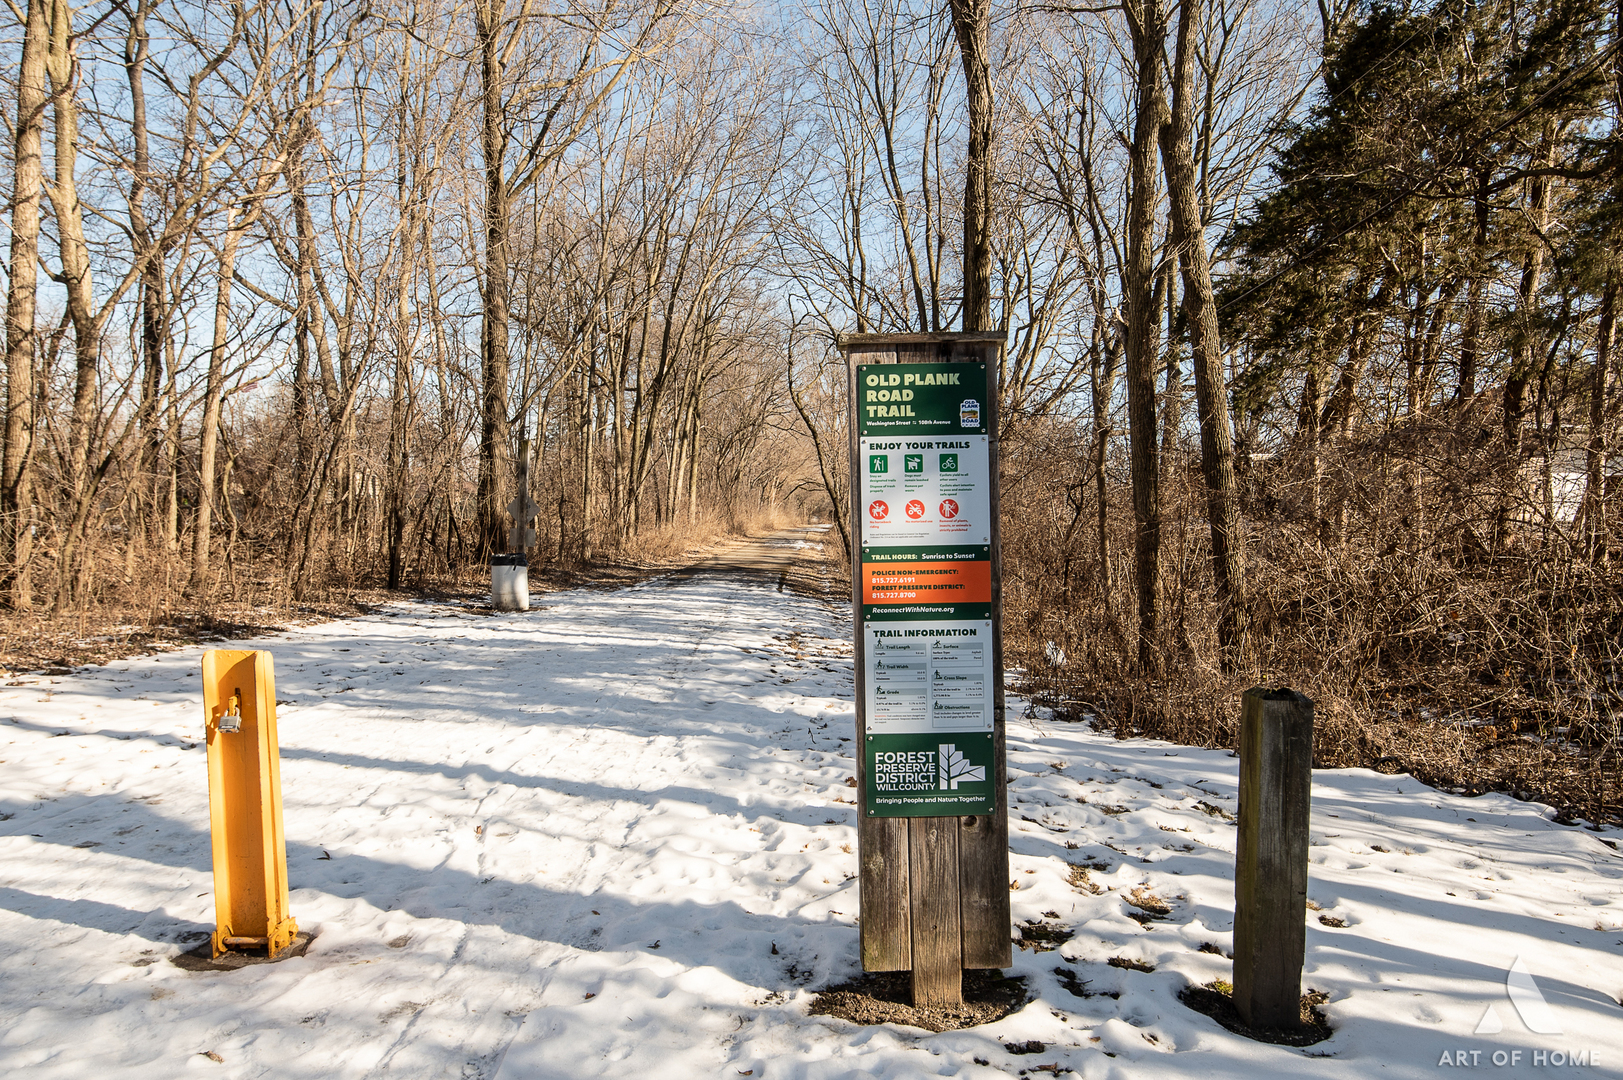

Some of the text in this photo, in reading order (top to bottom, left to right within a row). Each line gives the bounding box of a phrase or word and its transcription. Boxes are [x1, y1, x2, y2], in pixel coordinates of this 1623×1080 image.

[866, 373, 960, 386] OLD PLANK
[866, 390, 914, 402] ROAD
[866, 405, 915, 417] TRAIL
[904, 628, 977, 637] INFORMATION
[875, 752, 936, 763] FOREST
[875, 763, 936, 772] PRESERVE
[876, 773, 936, 783] DISTRICT
